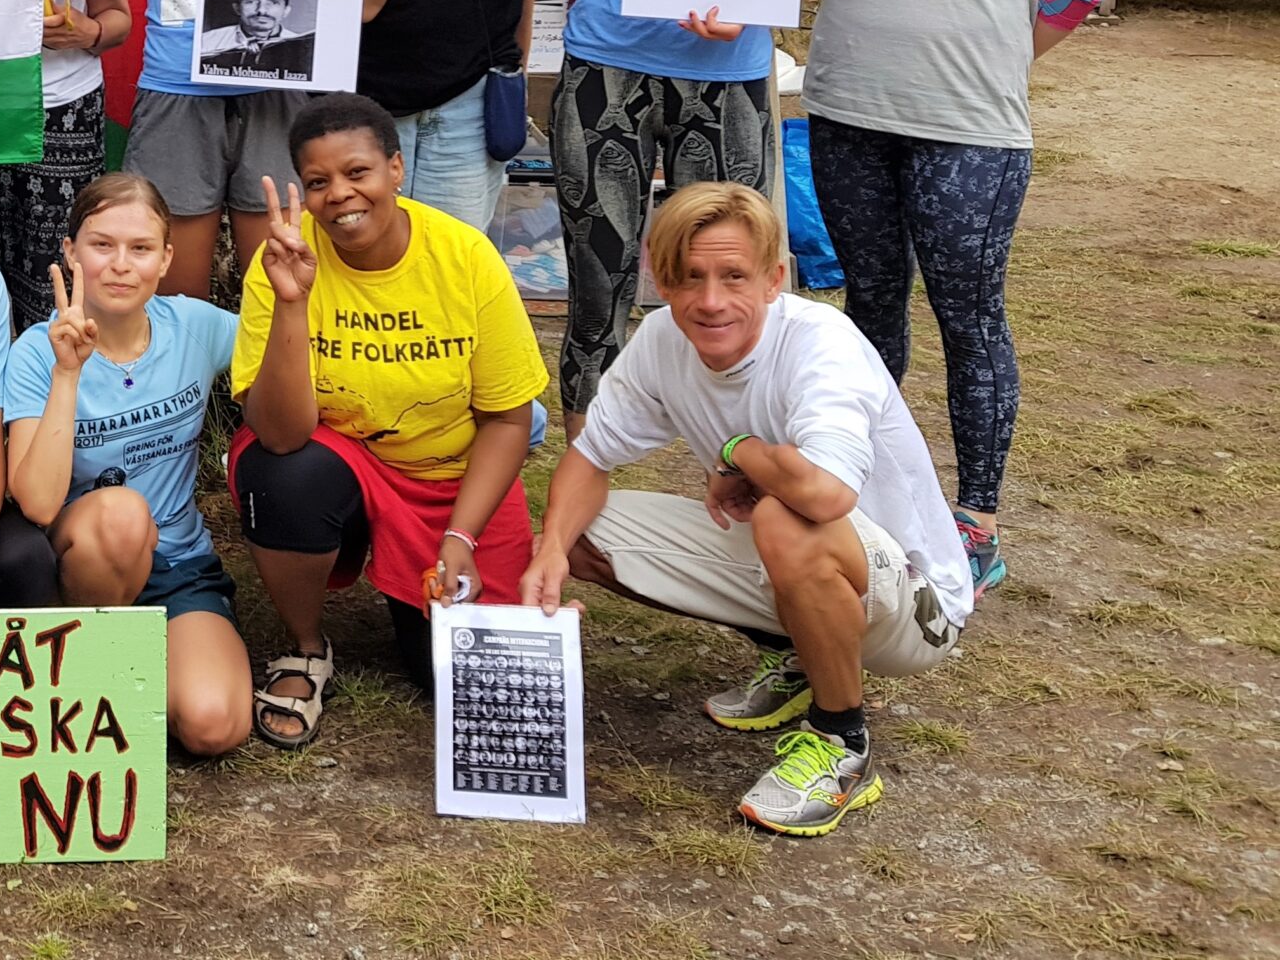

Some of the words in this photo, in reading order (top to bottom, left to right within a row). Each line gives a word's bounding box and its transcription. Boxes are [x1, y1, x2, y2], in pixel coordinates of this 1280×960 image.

[231, 66, 280, 80] Mohamed
[334, 309, 424, 332] HANDEL
[351, 335, 475, 363] FOLKRÄTT!
[77, 416, 128, 436] AHARA
[131, 385, 202, 426] MARATHON
[75, 435, 102, 447] 2017
[126, 440, 156, 455] SPRING
[156, 434, 174, 447] FÖR
[126, 444, 183, 466] VÄSTSAHARAS
[19, 767, 138, 857] NU
